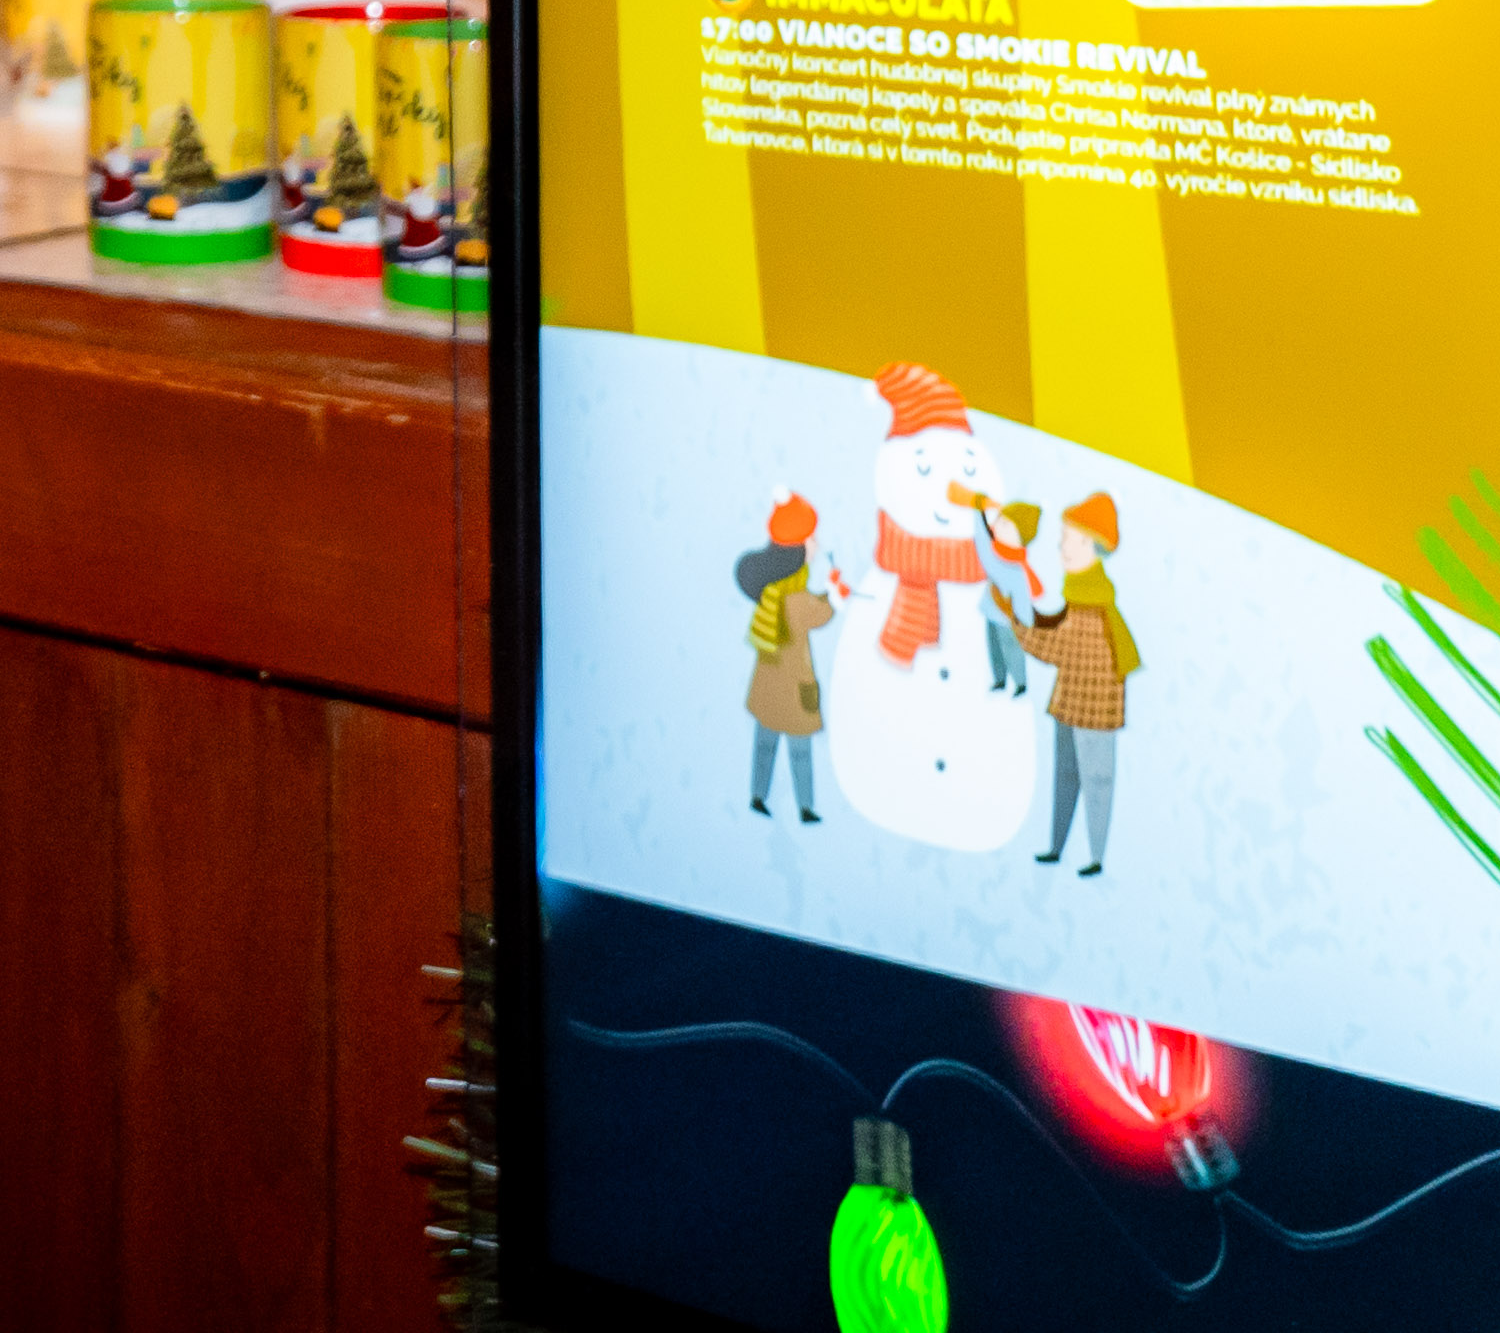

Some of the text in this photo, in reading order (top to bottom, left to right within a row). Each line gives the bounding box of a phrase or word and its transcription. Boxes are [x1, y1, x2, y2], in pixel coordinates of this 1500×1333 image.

[701, 16, 1206, 79] 17:00 VIANOCE SO SMOKIE REVIVAL
